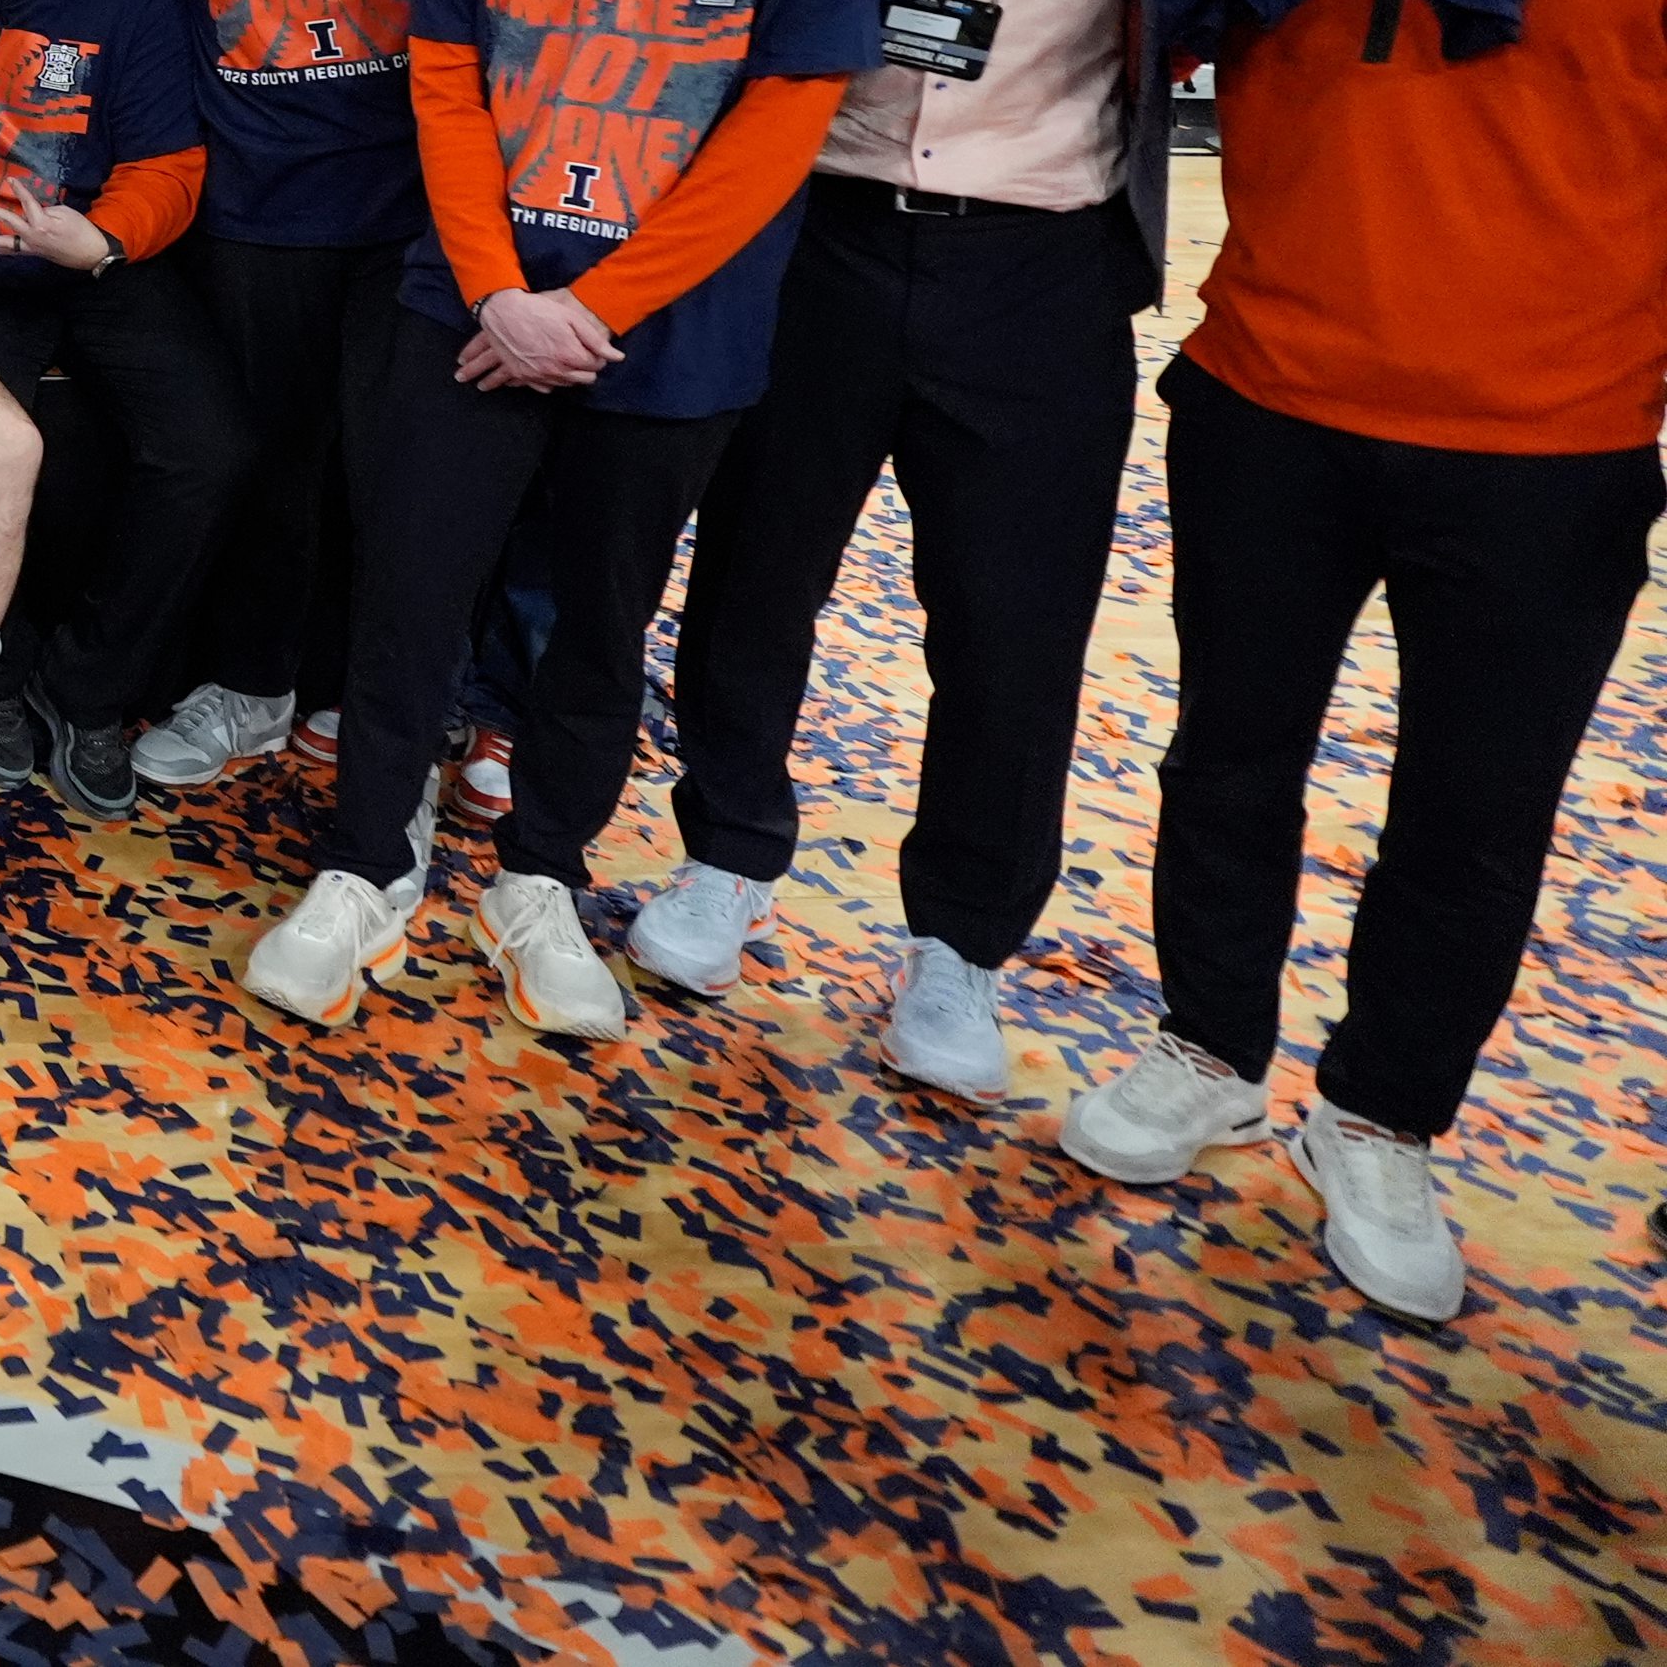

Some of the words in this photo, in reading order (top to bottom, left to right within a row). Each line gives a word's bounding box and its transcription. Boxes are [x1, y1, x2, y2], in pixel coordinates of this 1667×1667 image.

[217, 67, 248, 85] 2026
[251, 67, 302, 86] SOUTH
[305, 58, 390, 83] REGIONAL
[540, 209, 630, 239] REGIONA
